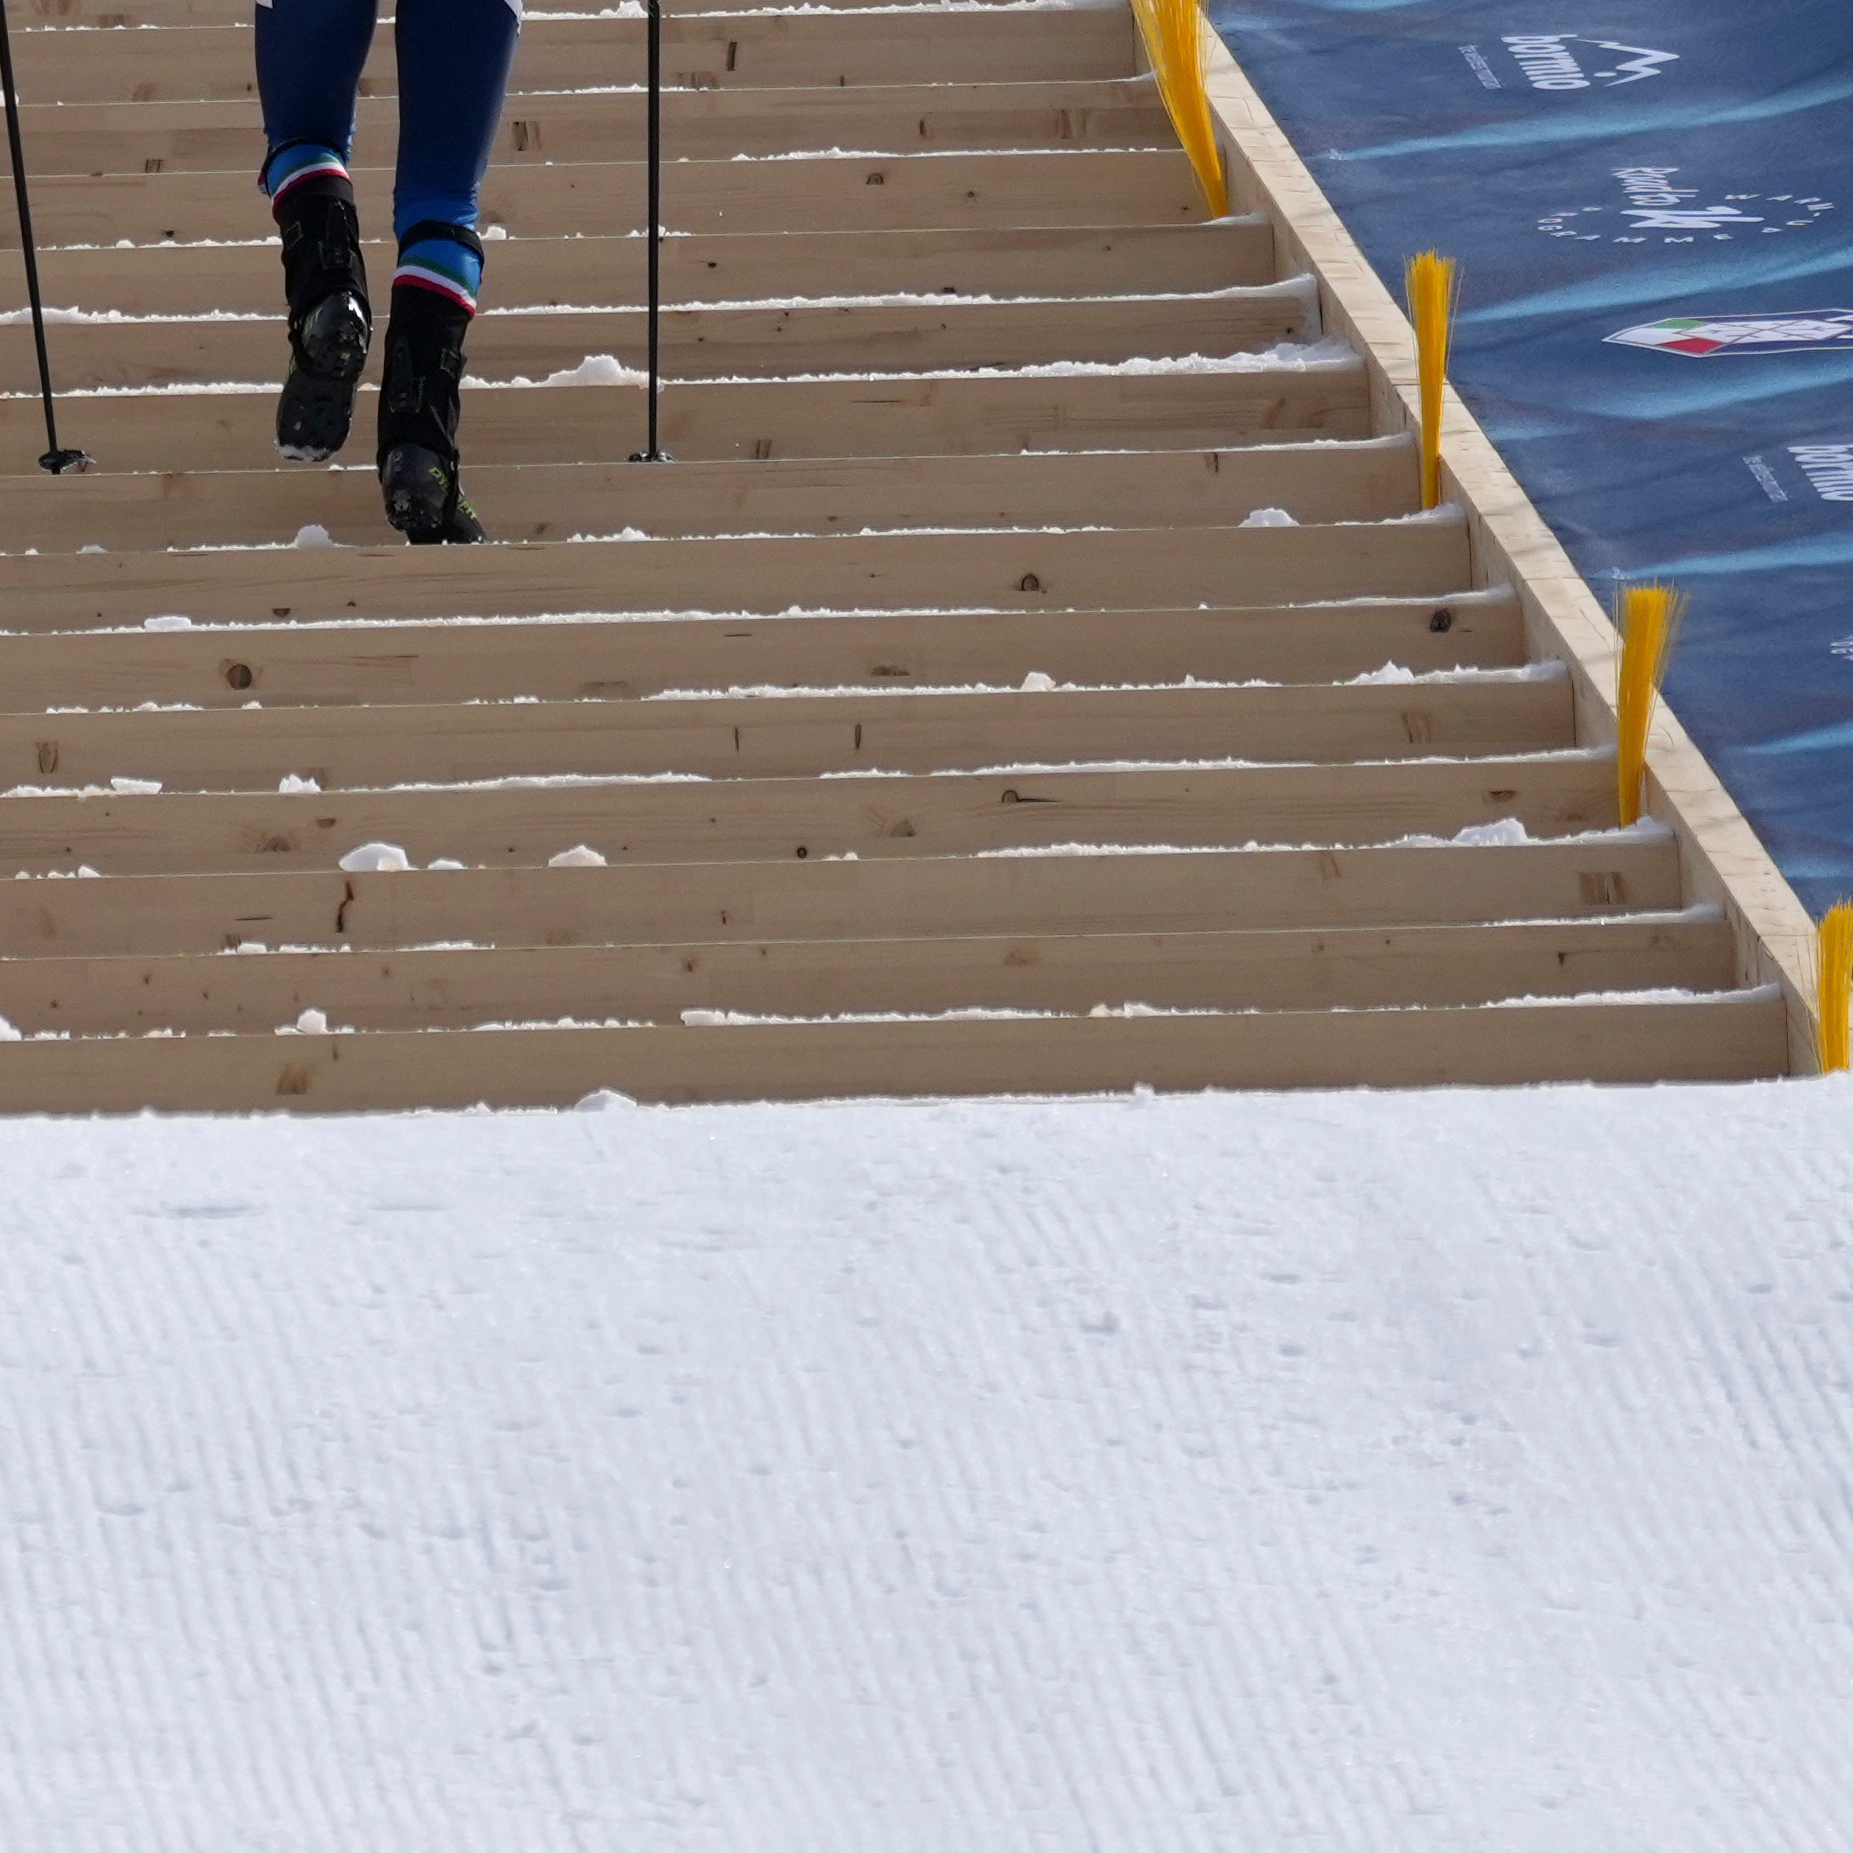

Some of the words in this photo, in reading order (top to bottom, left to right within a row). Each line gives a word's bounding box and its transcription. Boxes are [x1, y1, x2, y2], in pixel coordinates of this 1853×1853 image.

[1501, 34, 1591, 90] bormio
[1611, 166, 1700, 192] Road
[1537, 206, 1734, 244] PROGRAMME
